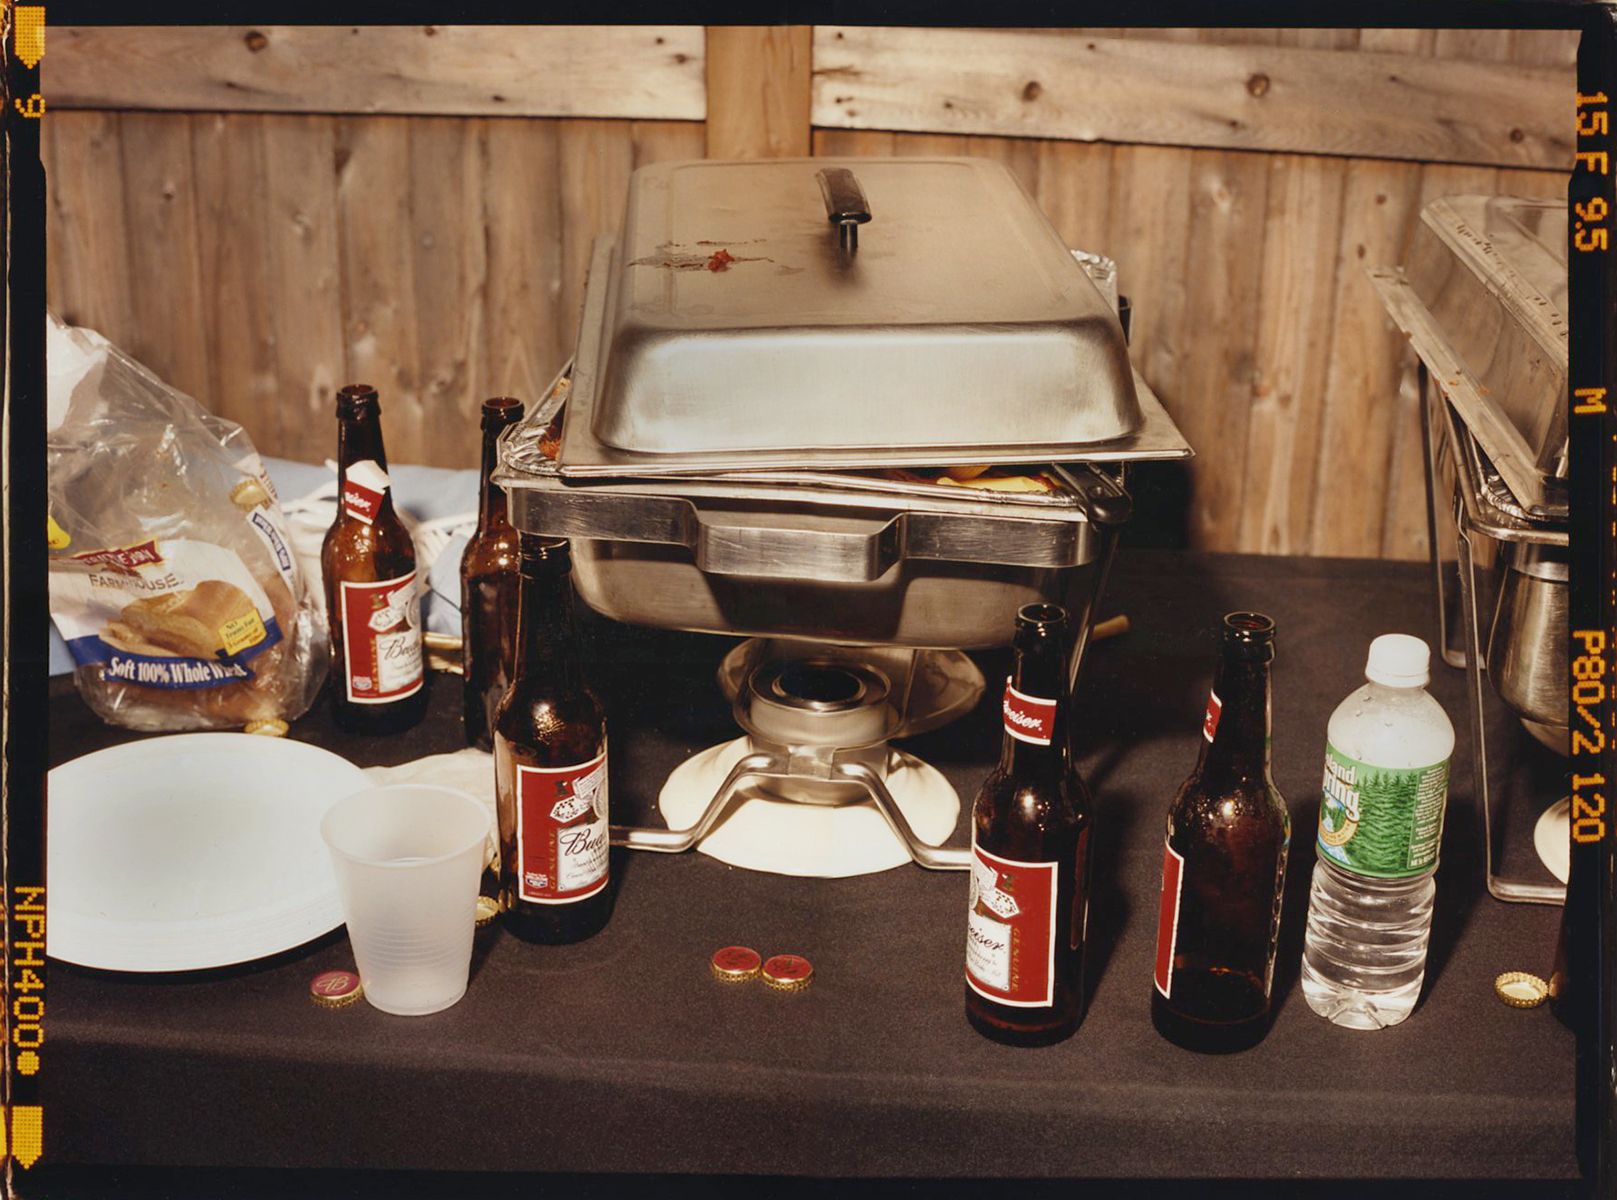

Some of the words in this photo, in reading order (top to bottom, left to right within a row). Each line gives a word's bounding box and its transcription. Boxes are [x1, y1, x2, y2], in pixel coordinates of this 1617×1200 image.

[1575, 92, 1608, 136] 15
[1575, 151, 1608, 175] F
[1574, 387, 1607, 414] M
[88, 572, 180, 591] FARMOUSE
[108, 656, 135, 680] Soft
[137, 661, 171, 683] 100%
[170, 661, 211, 684] Whole
[1572, 629, 1606, 755] P80/2
[1572, 772, 1606, 844] 120
[13, 886, 45, 1048] NPH400
